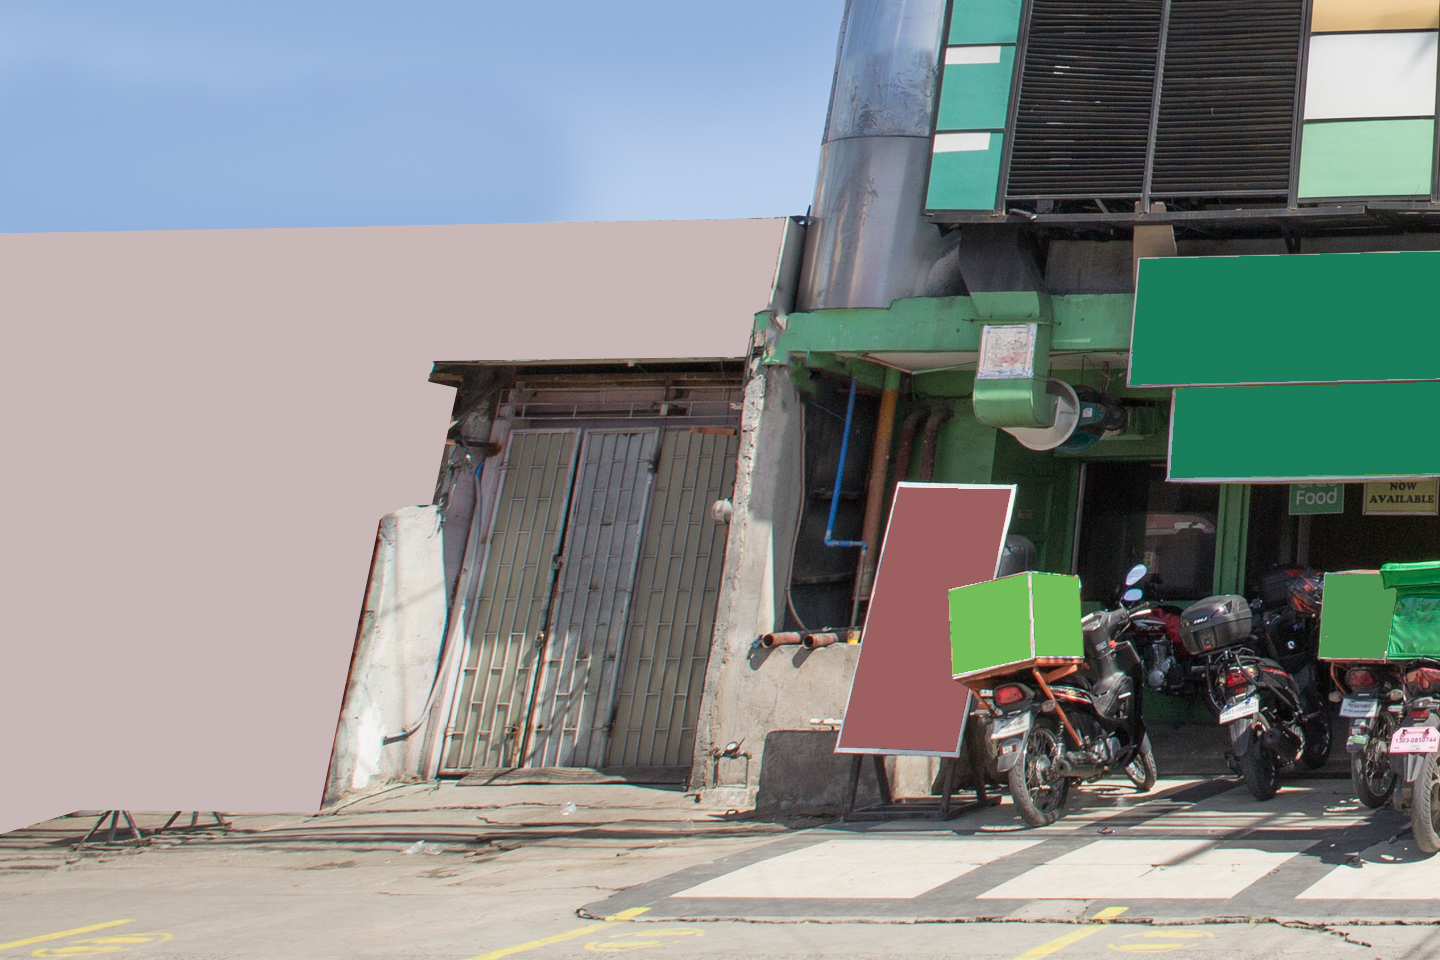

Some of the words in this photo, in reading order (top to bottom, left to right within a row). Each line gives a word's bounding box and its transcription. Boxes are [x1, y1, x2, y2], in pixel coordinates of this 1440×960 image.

[1389, 482, 1418, 491] NOW
[1296, 487, 1338, 505] Food
[1369, 494, 1435, 504] AVAILABLE
